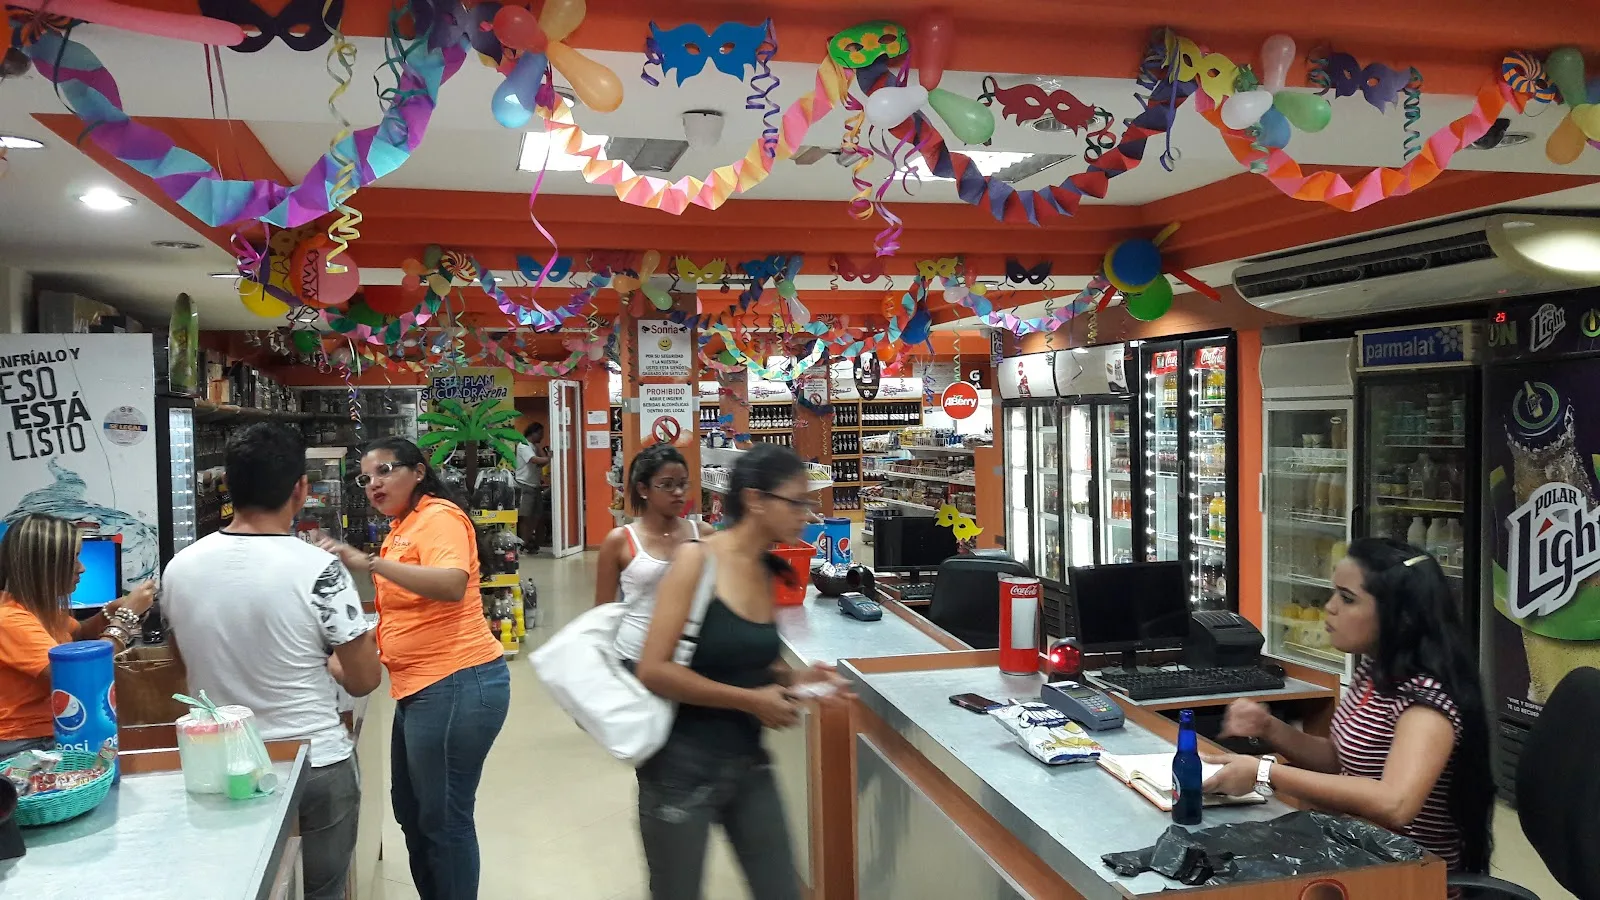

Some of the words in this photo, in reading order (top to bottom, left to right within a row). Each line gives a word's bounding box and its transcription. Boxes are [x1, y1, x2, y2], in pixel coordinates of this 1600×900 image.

[0, 349, 68, 369] NFRÍALO
[69, 347, 80, 360] Y
[1366, 336, 1436, 364] parmalat
[0, 366, 58, 405] ESO
[436, 387, 488, 399] CUADRA
[464, 375, 494, 387] PLAN
[11, 390, 92, 430] ESTÁ
[7, 422, 87, 461] LISTO
[1535, 488, 1578, 519] POLAR
[1010, 585, 1038, 596] Coca-Cola
